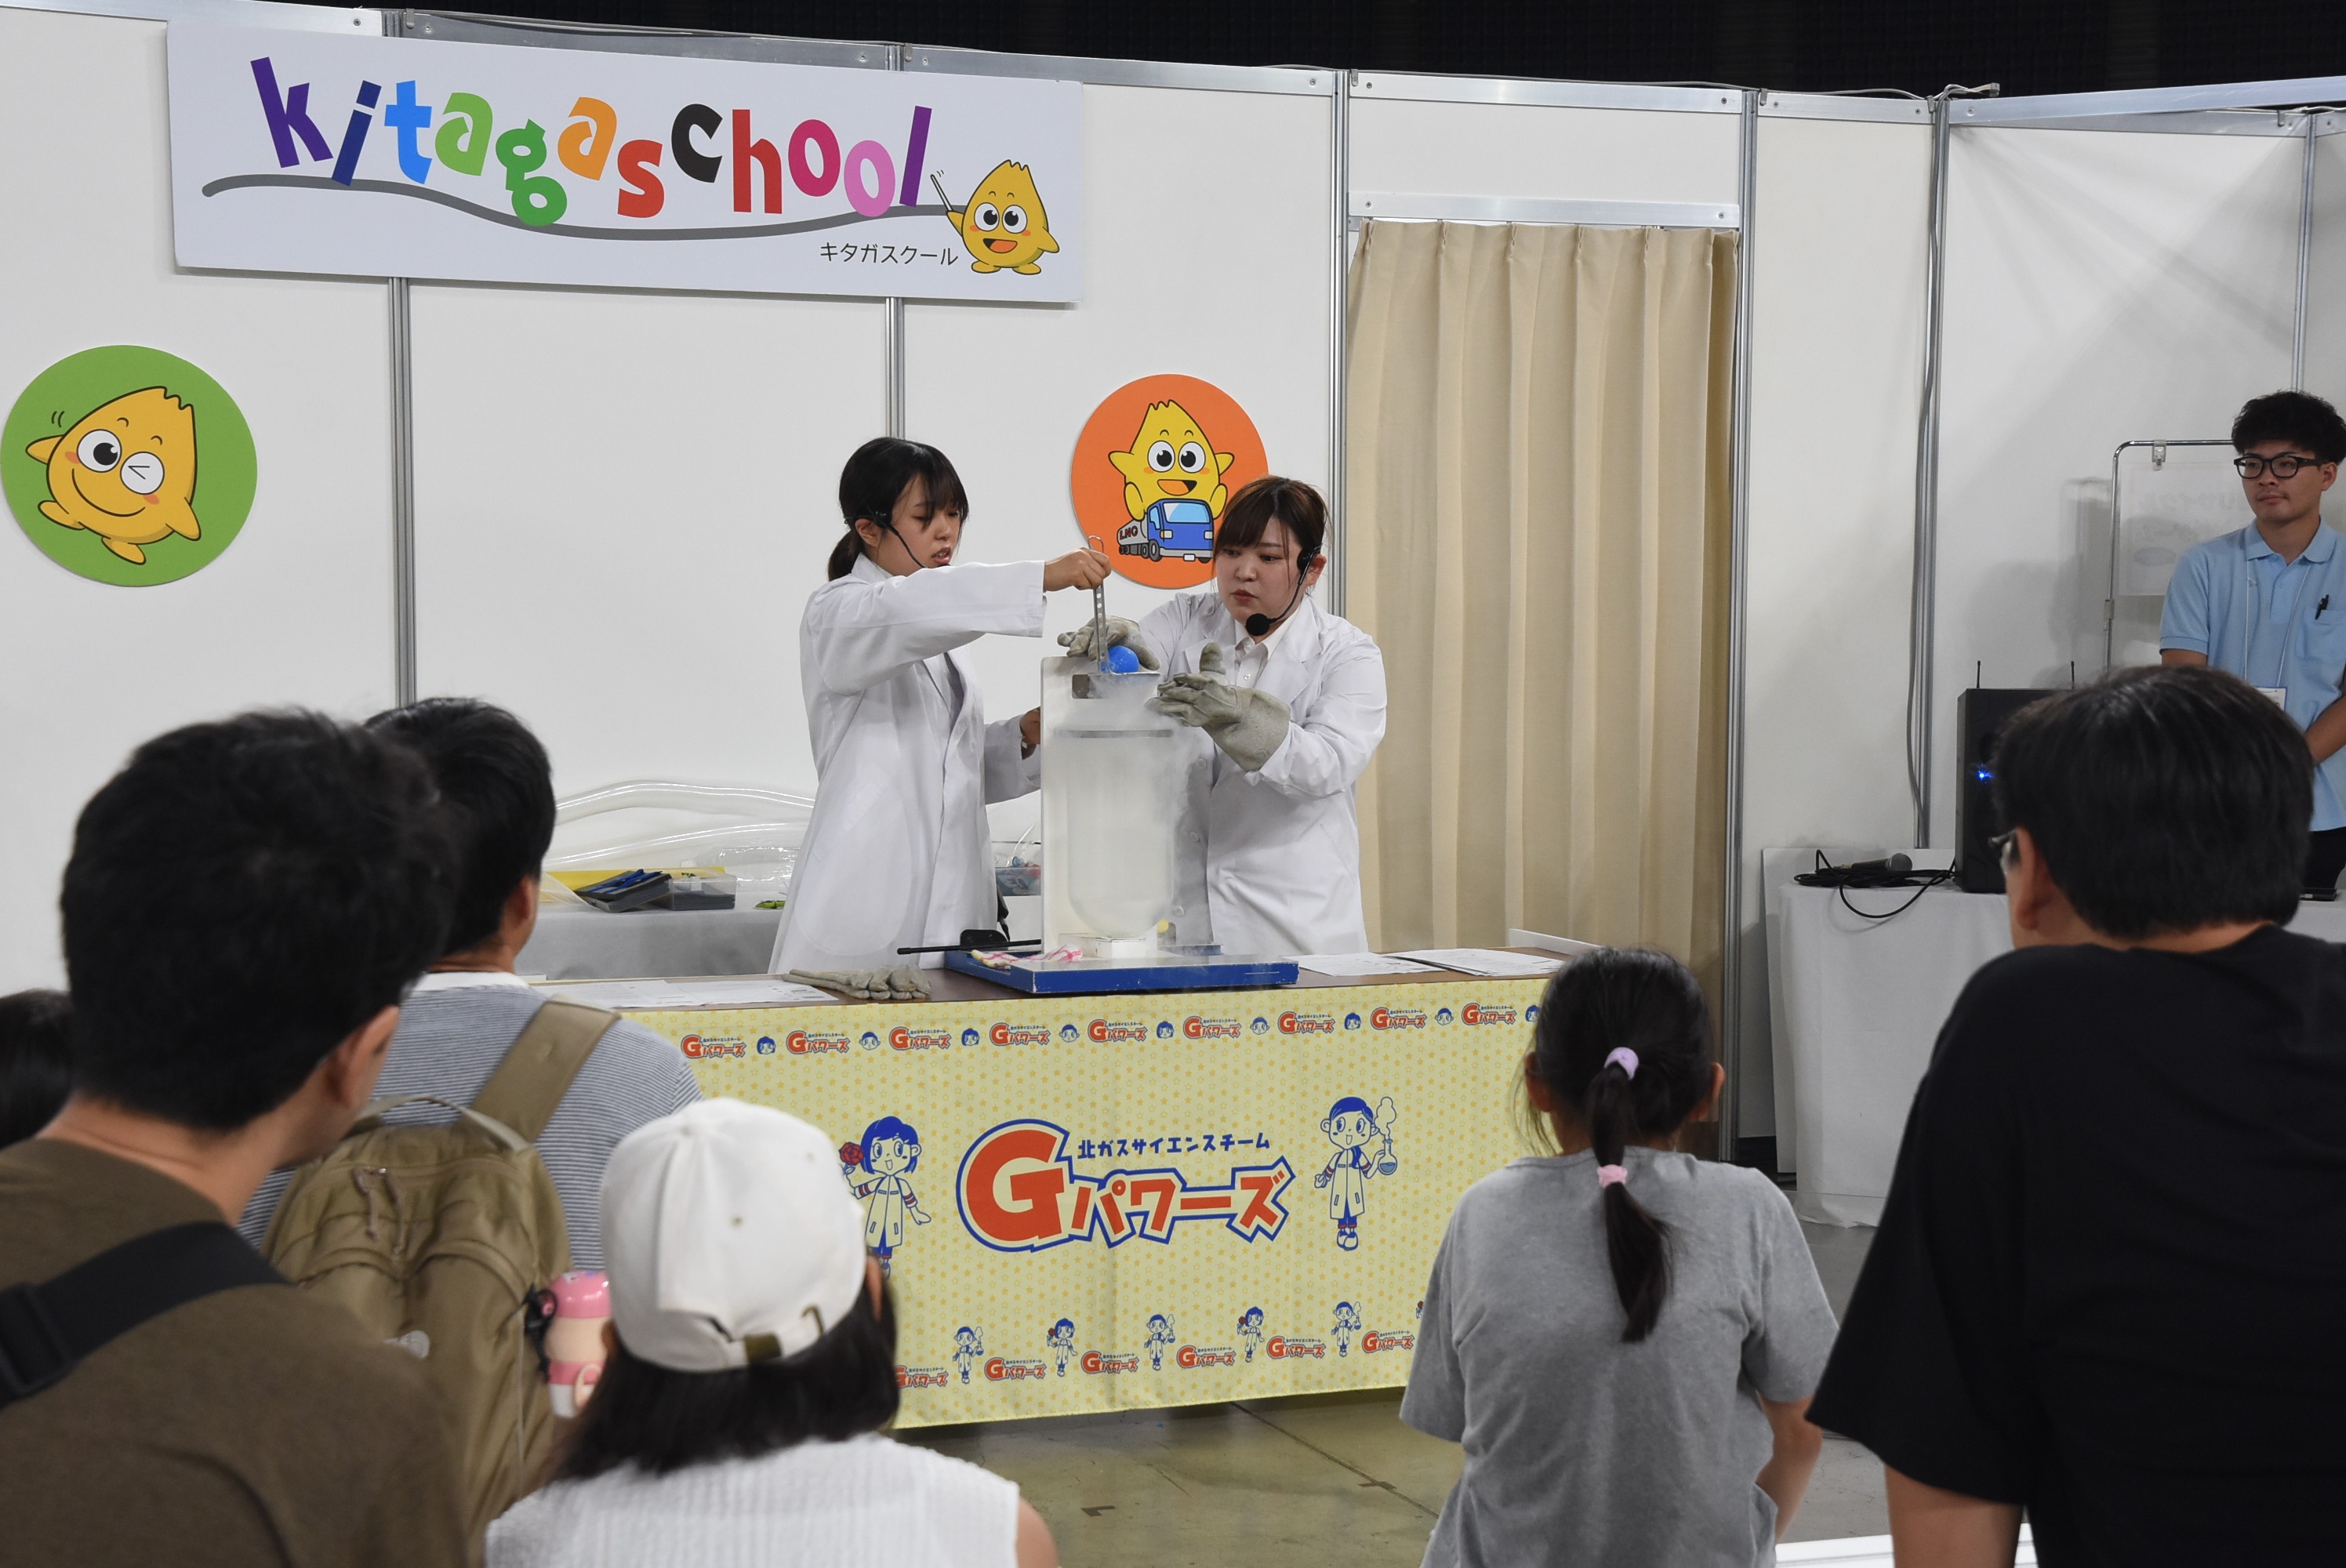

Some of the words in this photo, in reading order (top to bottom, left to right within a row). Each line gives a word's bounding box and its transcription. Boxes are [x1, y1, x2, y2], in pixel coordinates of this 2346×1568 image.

[249, 56, 933, 227] kitagaschool
[820, 241, 959, 267] キタガスクール
[1119, 525, 1138, 540] LNG
[1077, 1132, 1270, 1160] 北ガスサイエンスチーム
[964, 1127, 1288, 1245] Gパワーズ
